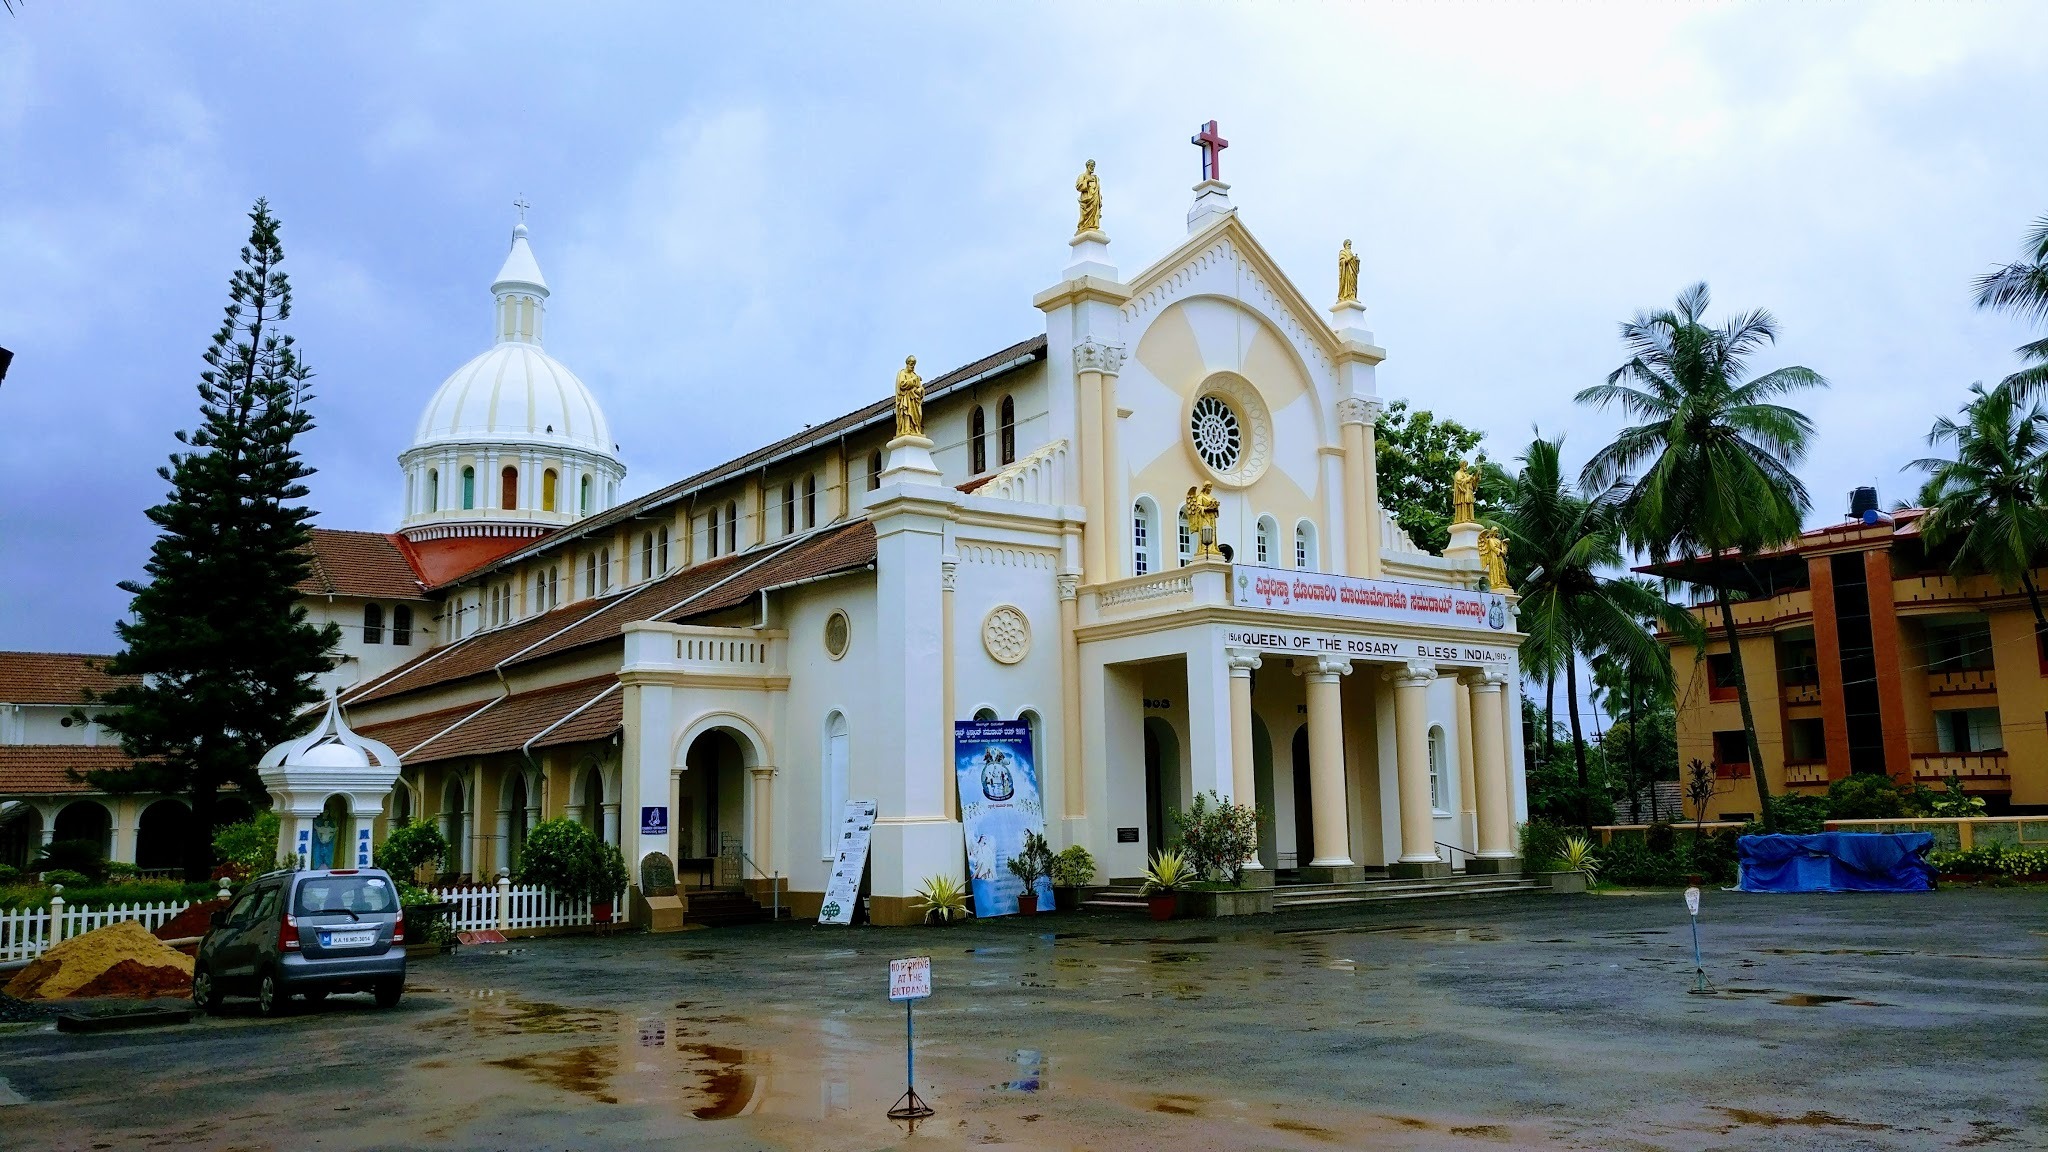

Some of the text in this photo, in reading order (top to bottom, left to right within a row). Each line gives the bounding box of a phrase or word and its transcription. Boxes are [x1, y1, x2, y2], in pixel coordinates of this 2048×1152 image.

[1242, 633, 1287, 647] QUEEN
[1293, 636, 1311, 648] OF
[1317, 638, 1342, 651] THE
[1348, 640, 1398, 655] ROSARY
[1417, 645, 1458, 659] BLESS
[358, 829, 370, 869] MAR
[891, 962, 900, 972] NO
[897, 972, 923, 984] AT THE
[891, 985, 929, 997] ENTRANCE
